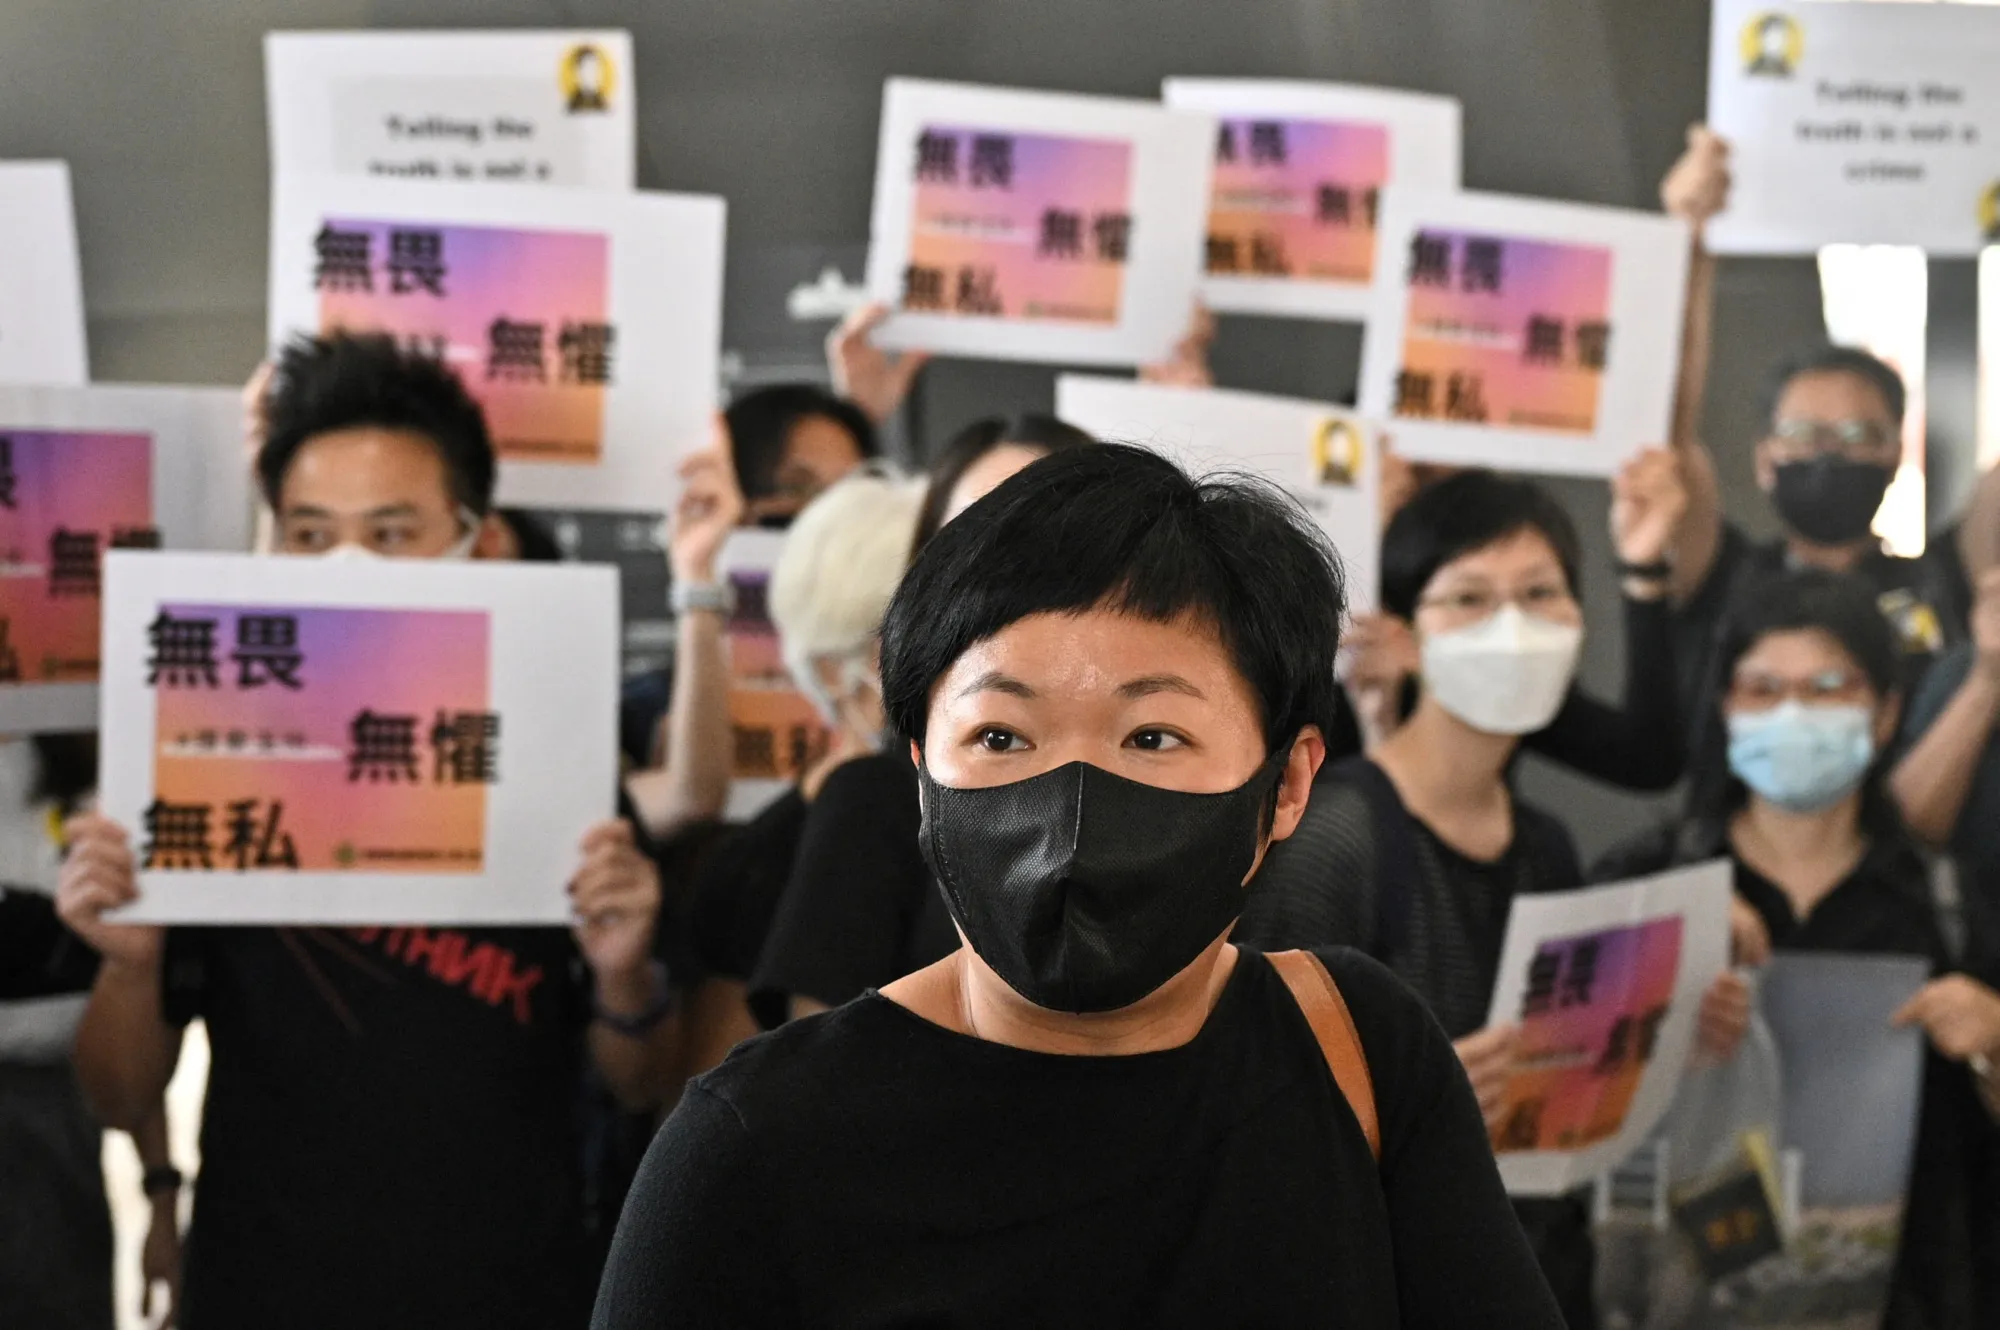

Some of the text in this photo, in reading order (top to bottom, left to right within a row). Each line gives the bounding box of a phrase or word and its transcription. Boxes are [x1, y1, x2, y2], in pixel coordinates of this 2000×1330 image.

[311, 218, 447, 298] 無畏
[486, 312, 616, 387] 無懼
[146, 606, 306, 690] 無畏
[346, 706, 503, 786] 無懼
[139, 796, 302, 870] 無私
